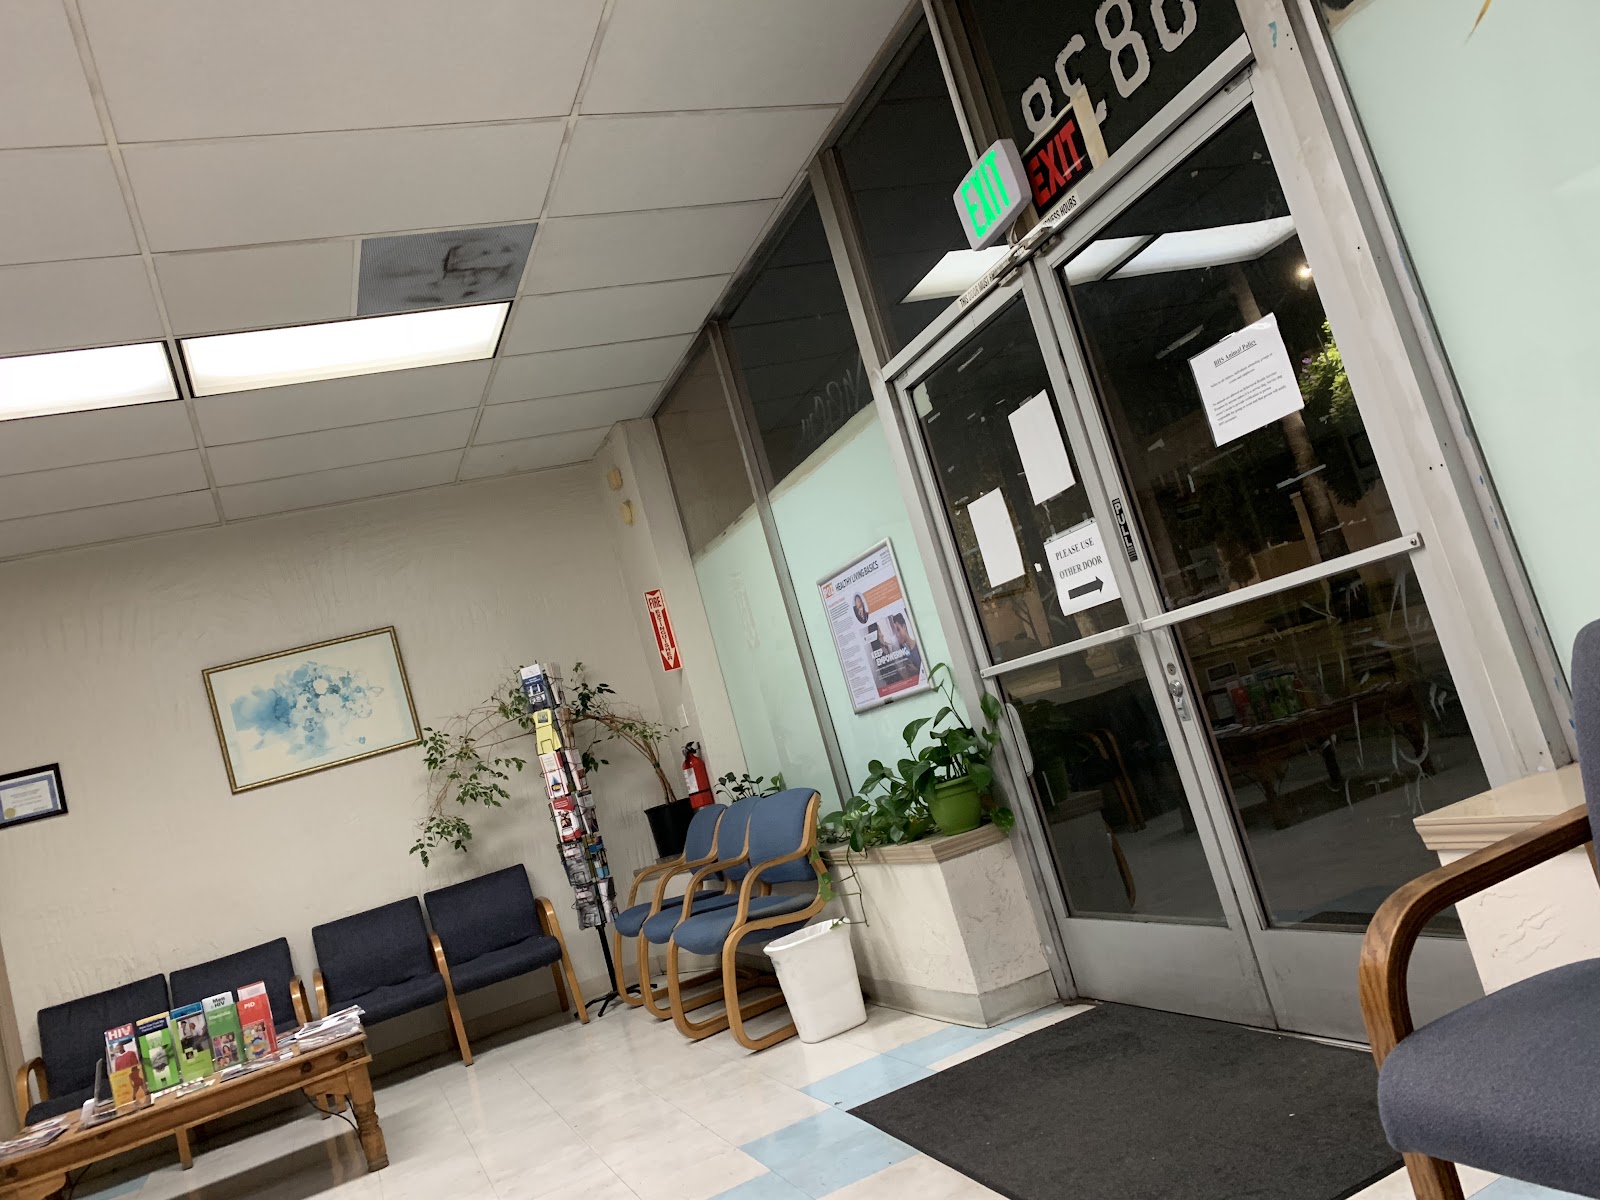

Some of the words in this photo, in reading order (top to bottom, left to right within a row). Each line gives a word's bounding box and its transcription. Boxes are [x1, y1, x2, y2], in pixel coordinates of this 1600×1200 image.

[1028, 119, 1082, 207] EXIT
[960, 150, 1010, 238] EXIT
[978, 275, 989, 292] MUST
[1060, 195, 1077, 216] HOURS
[1226, 347, 1242, 360] Animal
[1242, 340, 1256, 350] Policy
[1114, 502, 1132, 547] PULL
[1055, 544, 1080, 561] PLEASE
[1080, 537, 1094, 550] USE
[835, 577, 852, 590] HEALTHY
[851, 568, 864, 583] LIVING
[864, 560, 879, 575] BASICS
[1059, 561, 1082, 579] OTHER
[1082, 555, 1103, 570] DOOR
[108, 1026, 132, 1041] HIV
